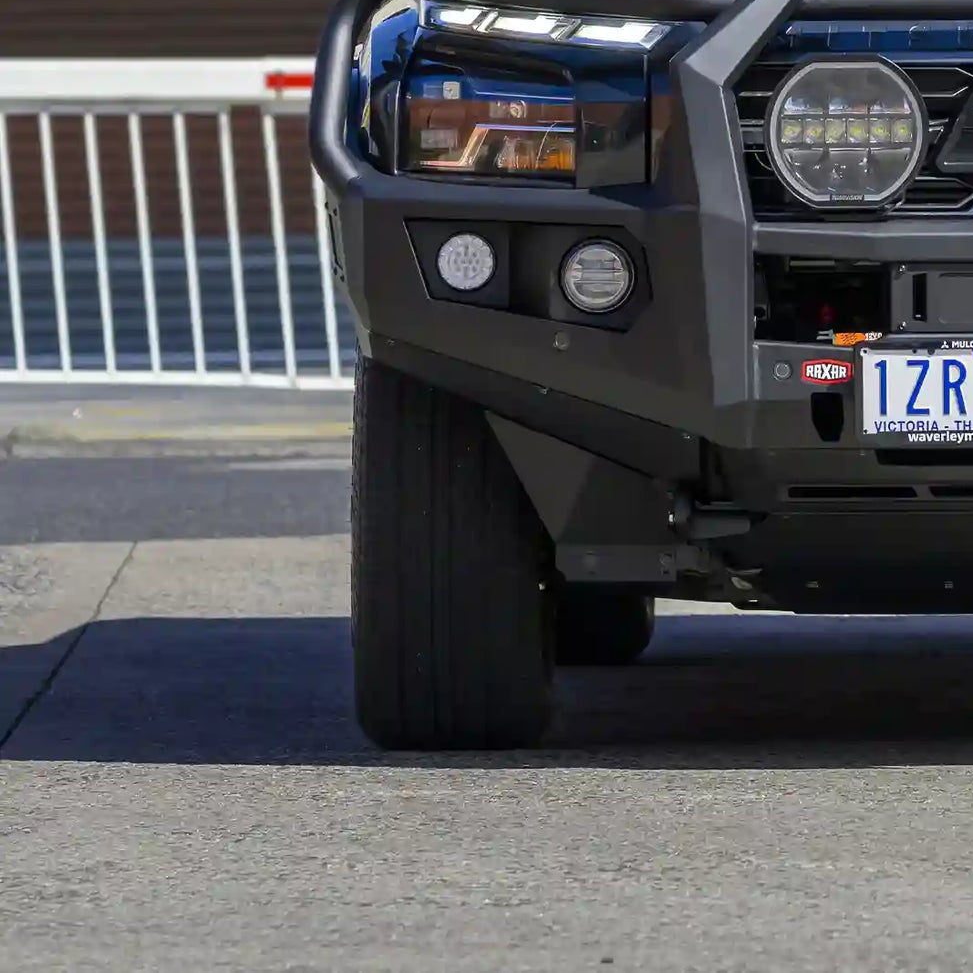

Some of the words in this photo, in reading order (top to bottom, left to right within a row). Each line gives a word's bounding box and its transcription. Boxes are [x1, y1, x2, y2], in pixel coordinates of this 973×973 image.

[805, 363, 847, 380] RAXAR
[873, 359, 968, 416] 1ZR
[873, 420, 940, 433] VICTORIA
